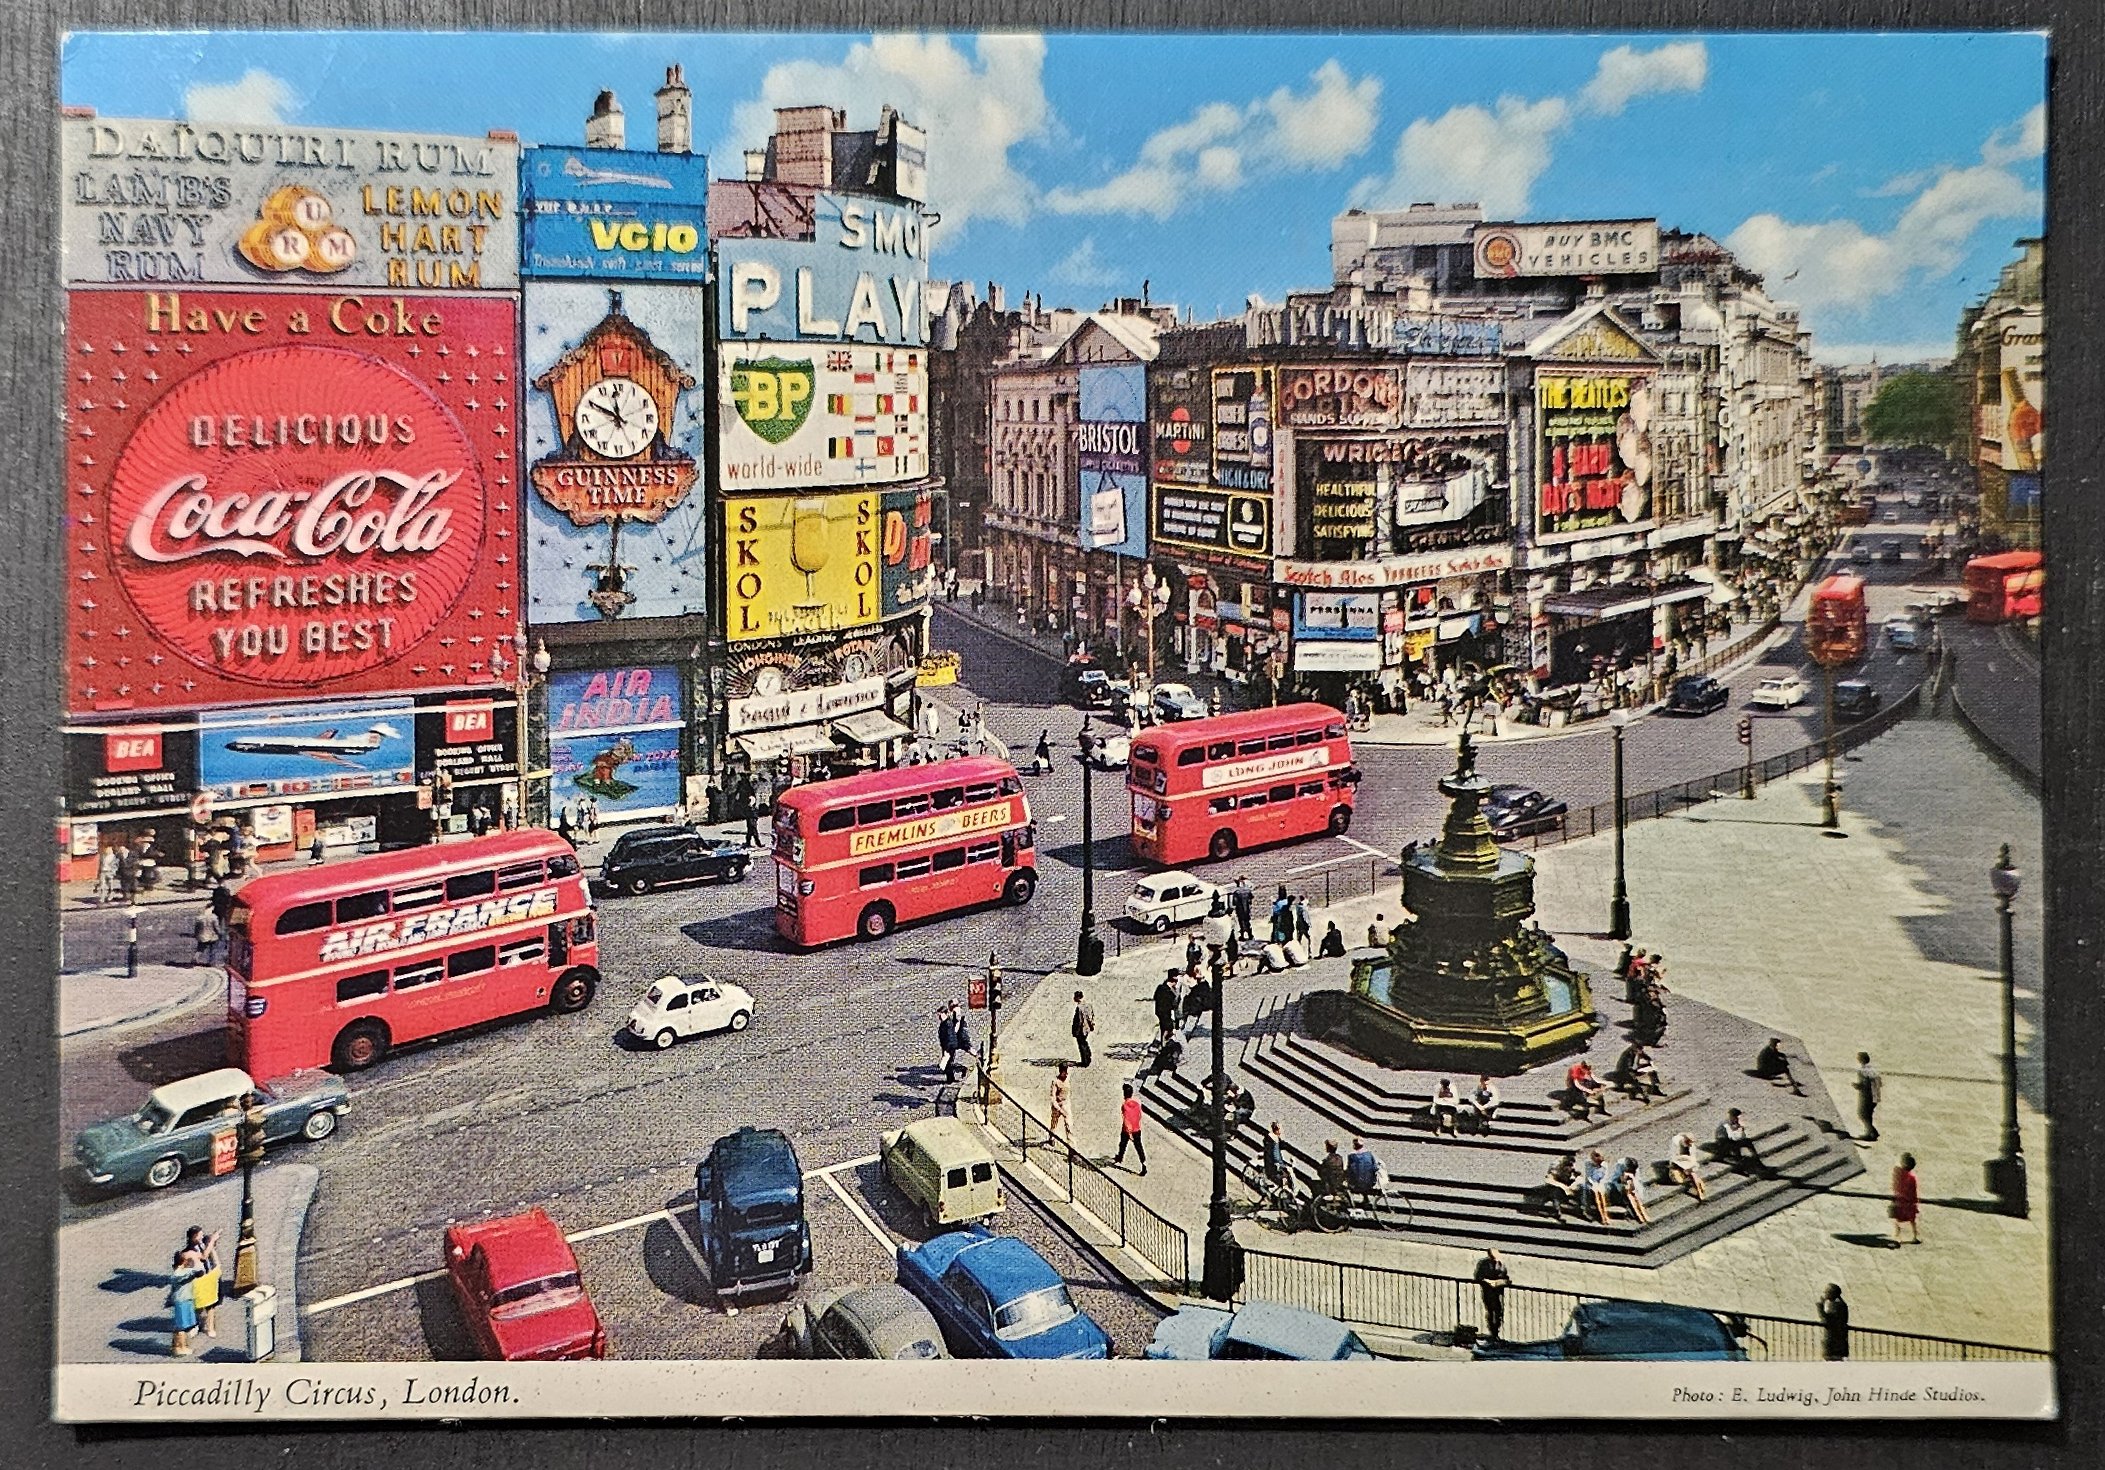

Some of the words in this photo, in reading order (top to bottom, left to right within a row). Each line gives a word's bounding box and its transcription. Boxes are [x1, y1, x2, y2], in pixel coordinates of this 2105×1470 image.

[87, 124, 355, 169] DAIQUIRI
[377, 140, 495, 177] RUM
[303, 202, 323, 221] U
[361, 183, 502, 220] LEMON
[99, 211, 211, 246] NAVY
[282, 230, 301, 255] R
[326, 236, 351, 256] M
[380, 221, 490, 255] HART
[1544, 233, 1584, 249] BUY
[1590, 230, 1633, 248] BMC
[106, 251, 204, 282] RUM
[387, 258, 482, 288] RUM
[1528, 251, 1648, 268] VEHICLES
[146, 291, 267, 336] Have
[288, 308, 310, 335] a
[329, 295, 443, 337] Coke
[746, 370, 811, 421] BP
[190, 412, 417, 447] DELICIOUS
[1078, 422, 1140, 455] BRISTOL
[1155, 422, 1206, 440] MARTINI
[557, 465, 680, 488] GUINNESS
[727, 453, 823, 480] world-wide
[588, 486, 648, 505] TIME
[128, 468, 464, 563] Coca-Cola
[735, 506, 762, 632] SKOL
[854, 500, 873, 619] SKOL
[190, 570, 419, 612] REFRESHES
[211, 622, 288, 658] YOU
[305, 617, 395, 654] BEST
[582, 669, 653, 701] AIR
[452, 711, 487, 731] BEA
[559, 694, 673, 730] INDIA
[115, 739, 155, 759] BEA
[1228, 764, 1266, 778] LONG
[1268, 756, 1304, 772] JOHN
[854, 821, 937, 851] FREMLINS
[961, 806, 1008, 829] BEERS
[322, 922, 396, 956] AIR
[401, 889, 558, 938] FRANCE
[133, 1379, 272, 1413] Piccadilly
[285, 1377, 388, 1411] Circus,
[402, 1376, 520, 1405] London.
[1731, 1387, 1749, 1402] E.
[1821, 1386, 1861, 1406] John
[1867, 1386, 1917, 1402] Hinde
[1923, 1386, 1986, 1402] Studios.
